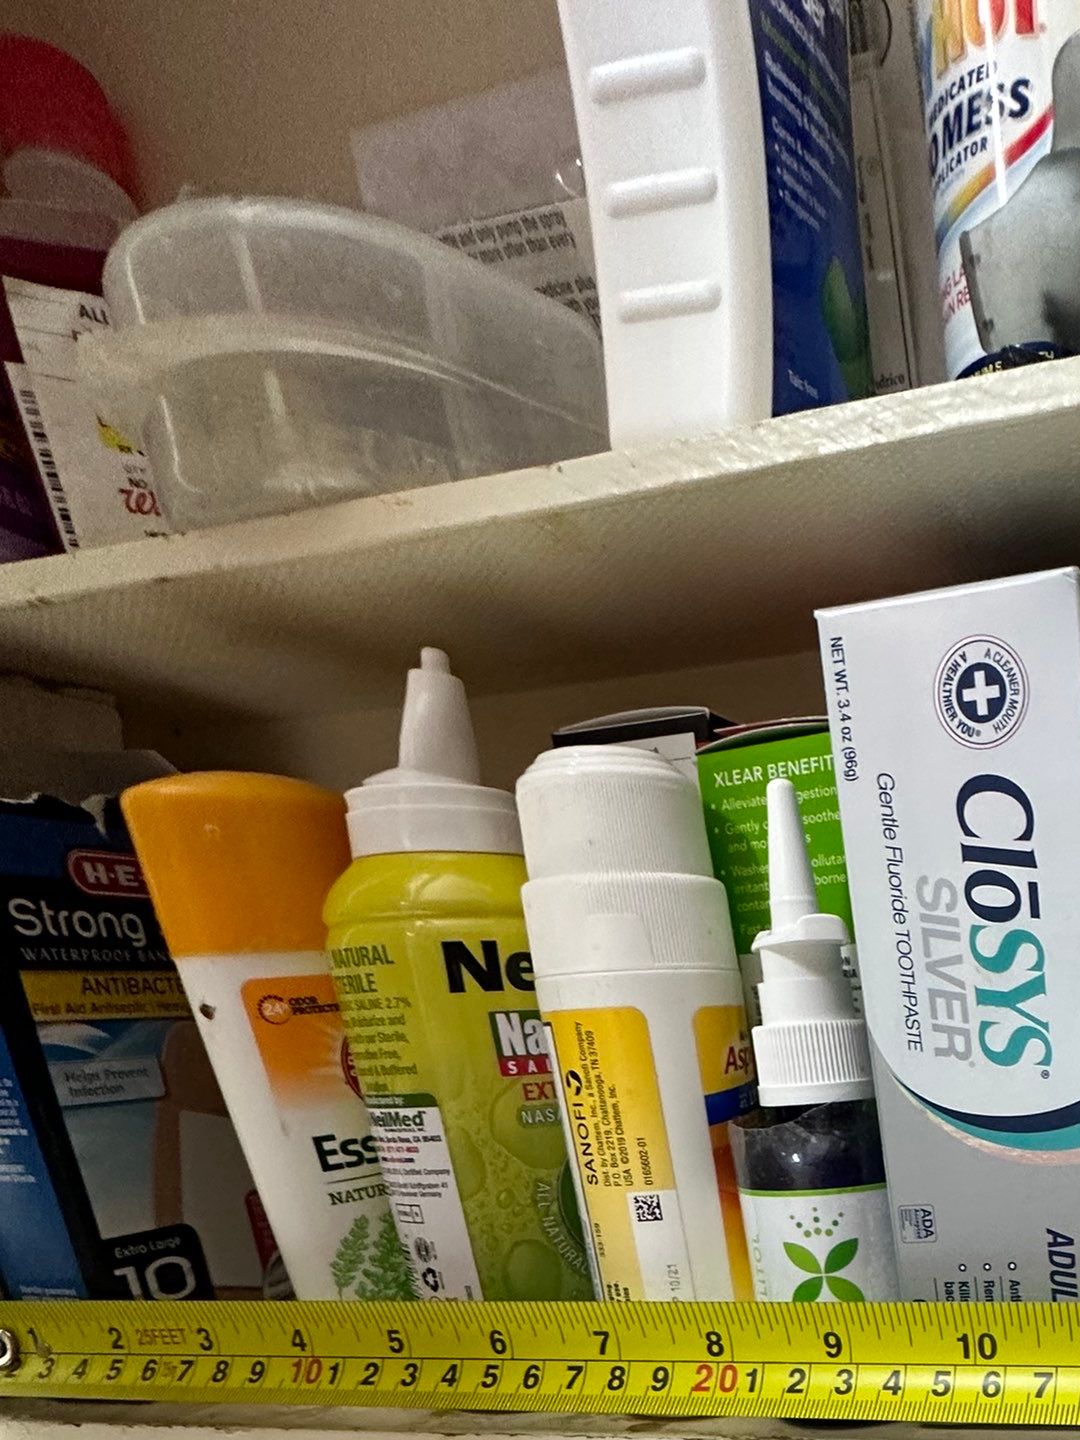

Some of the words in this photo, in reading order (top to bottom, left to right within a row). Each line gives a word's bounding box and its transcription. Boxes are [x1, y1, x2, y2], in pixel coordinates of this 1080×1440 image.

[830, 636, 845, 664] NET
[834, 671, 849, 695] WT.
[992, 651, 1019, 696] CLEANER
[942, 662, 961, 722] HEALTHIER
[837, 699, 852, 722] 3.4
[992, 699, 1019, 734] MOUTH
[841, 727, 852, 742] oz
[714, 766, 763, 788] XLEAR
[842, 746, 859, 782] (96g)
[876, 772, 899, 841] Gentle
[885, 848, 909, 926] Fluoride
[8, 898, 147, 947] Strong
[20, 947, 130, 963] WATERPROOF
[895, 929, 922, 1052] TOOTHPASTE
[574, 1022, 587, 1061] Company
[591, 1059, 599, 1069] TN
[573, 1103, 598, 1185] SANOFI
[610, 1153, 619, 1168] Box
[622, 1168, 633, 1186] USA
[920, 1209, 934, 1239] ADA
[114, 1244, 147, 1258] Extra
[113, 1256, 196, 1300] 10
[108, 1327, 125, 1349] 2
[197, 1327, 213, 1351] 3
[291, 1329, 307, 1352] 4
[386, 1329, 404, 1354] 5
[489, 1330, 507, 1354] 6
[592, 1330, 610, 1355] 7
[705, 1331, 725, 1357] 8
[823, 1331, 843, 1358] 9
[957, 1332, 997, 1360] 10
[291, 1356, 323, 1384] 10
[692, 1363, 738, 1393] 20
[746, 1368, 758, 1392] 1
[786, 1368, 806, 1394] 2
[834, 1368, 854, 1395] 3
[882, 1369, 903, 1396] 4
[931, 1370, 952, 1397] 5
[982, 1370, 1001, 1398] 6
[1034, 1372, 1054, 1399] 7
